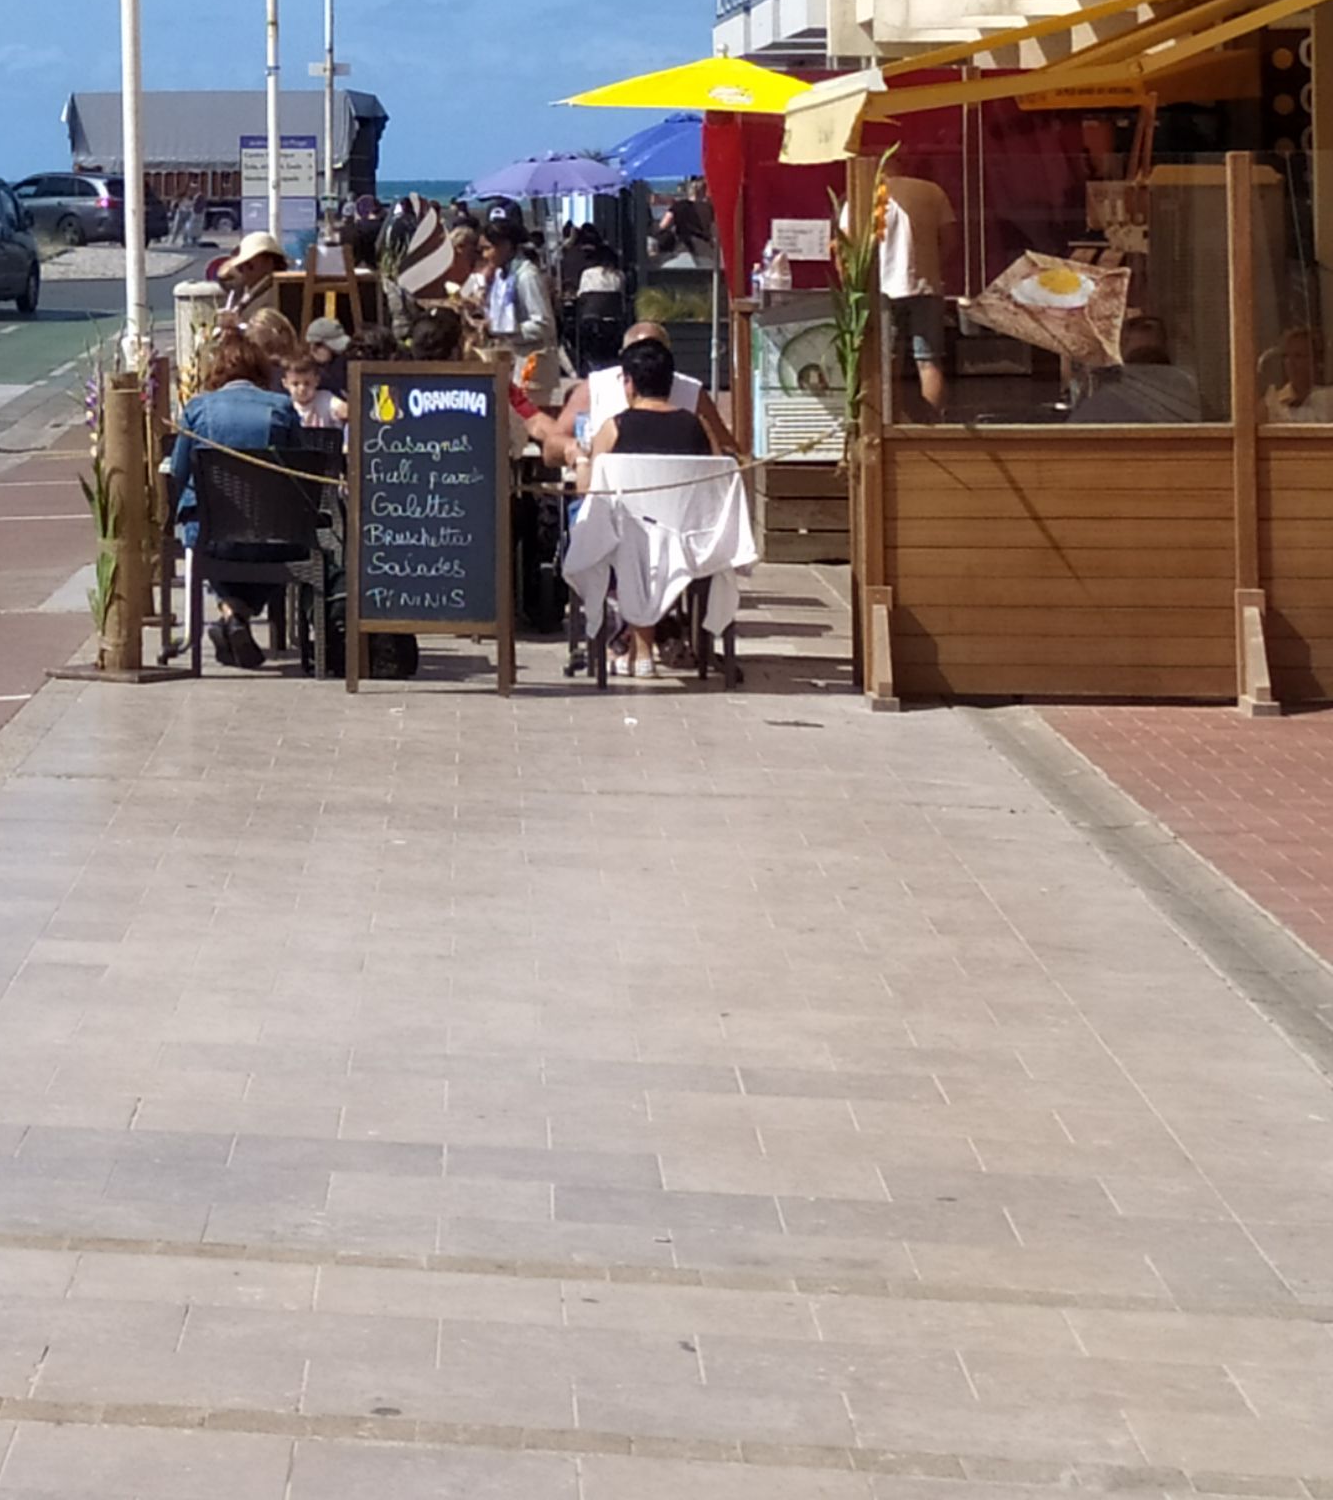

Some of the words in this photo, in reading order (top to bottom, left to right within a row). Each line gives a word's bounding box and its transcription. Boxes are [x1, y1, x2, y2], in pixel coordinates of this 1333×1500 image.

[408, 388, 487, 418] ORANGINA
[363, 425, 473, 462] Lasagnes
[370, 491, 466, 519] Galettes
